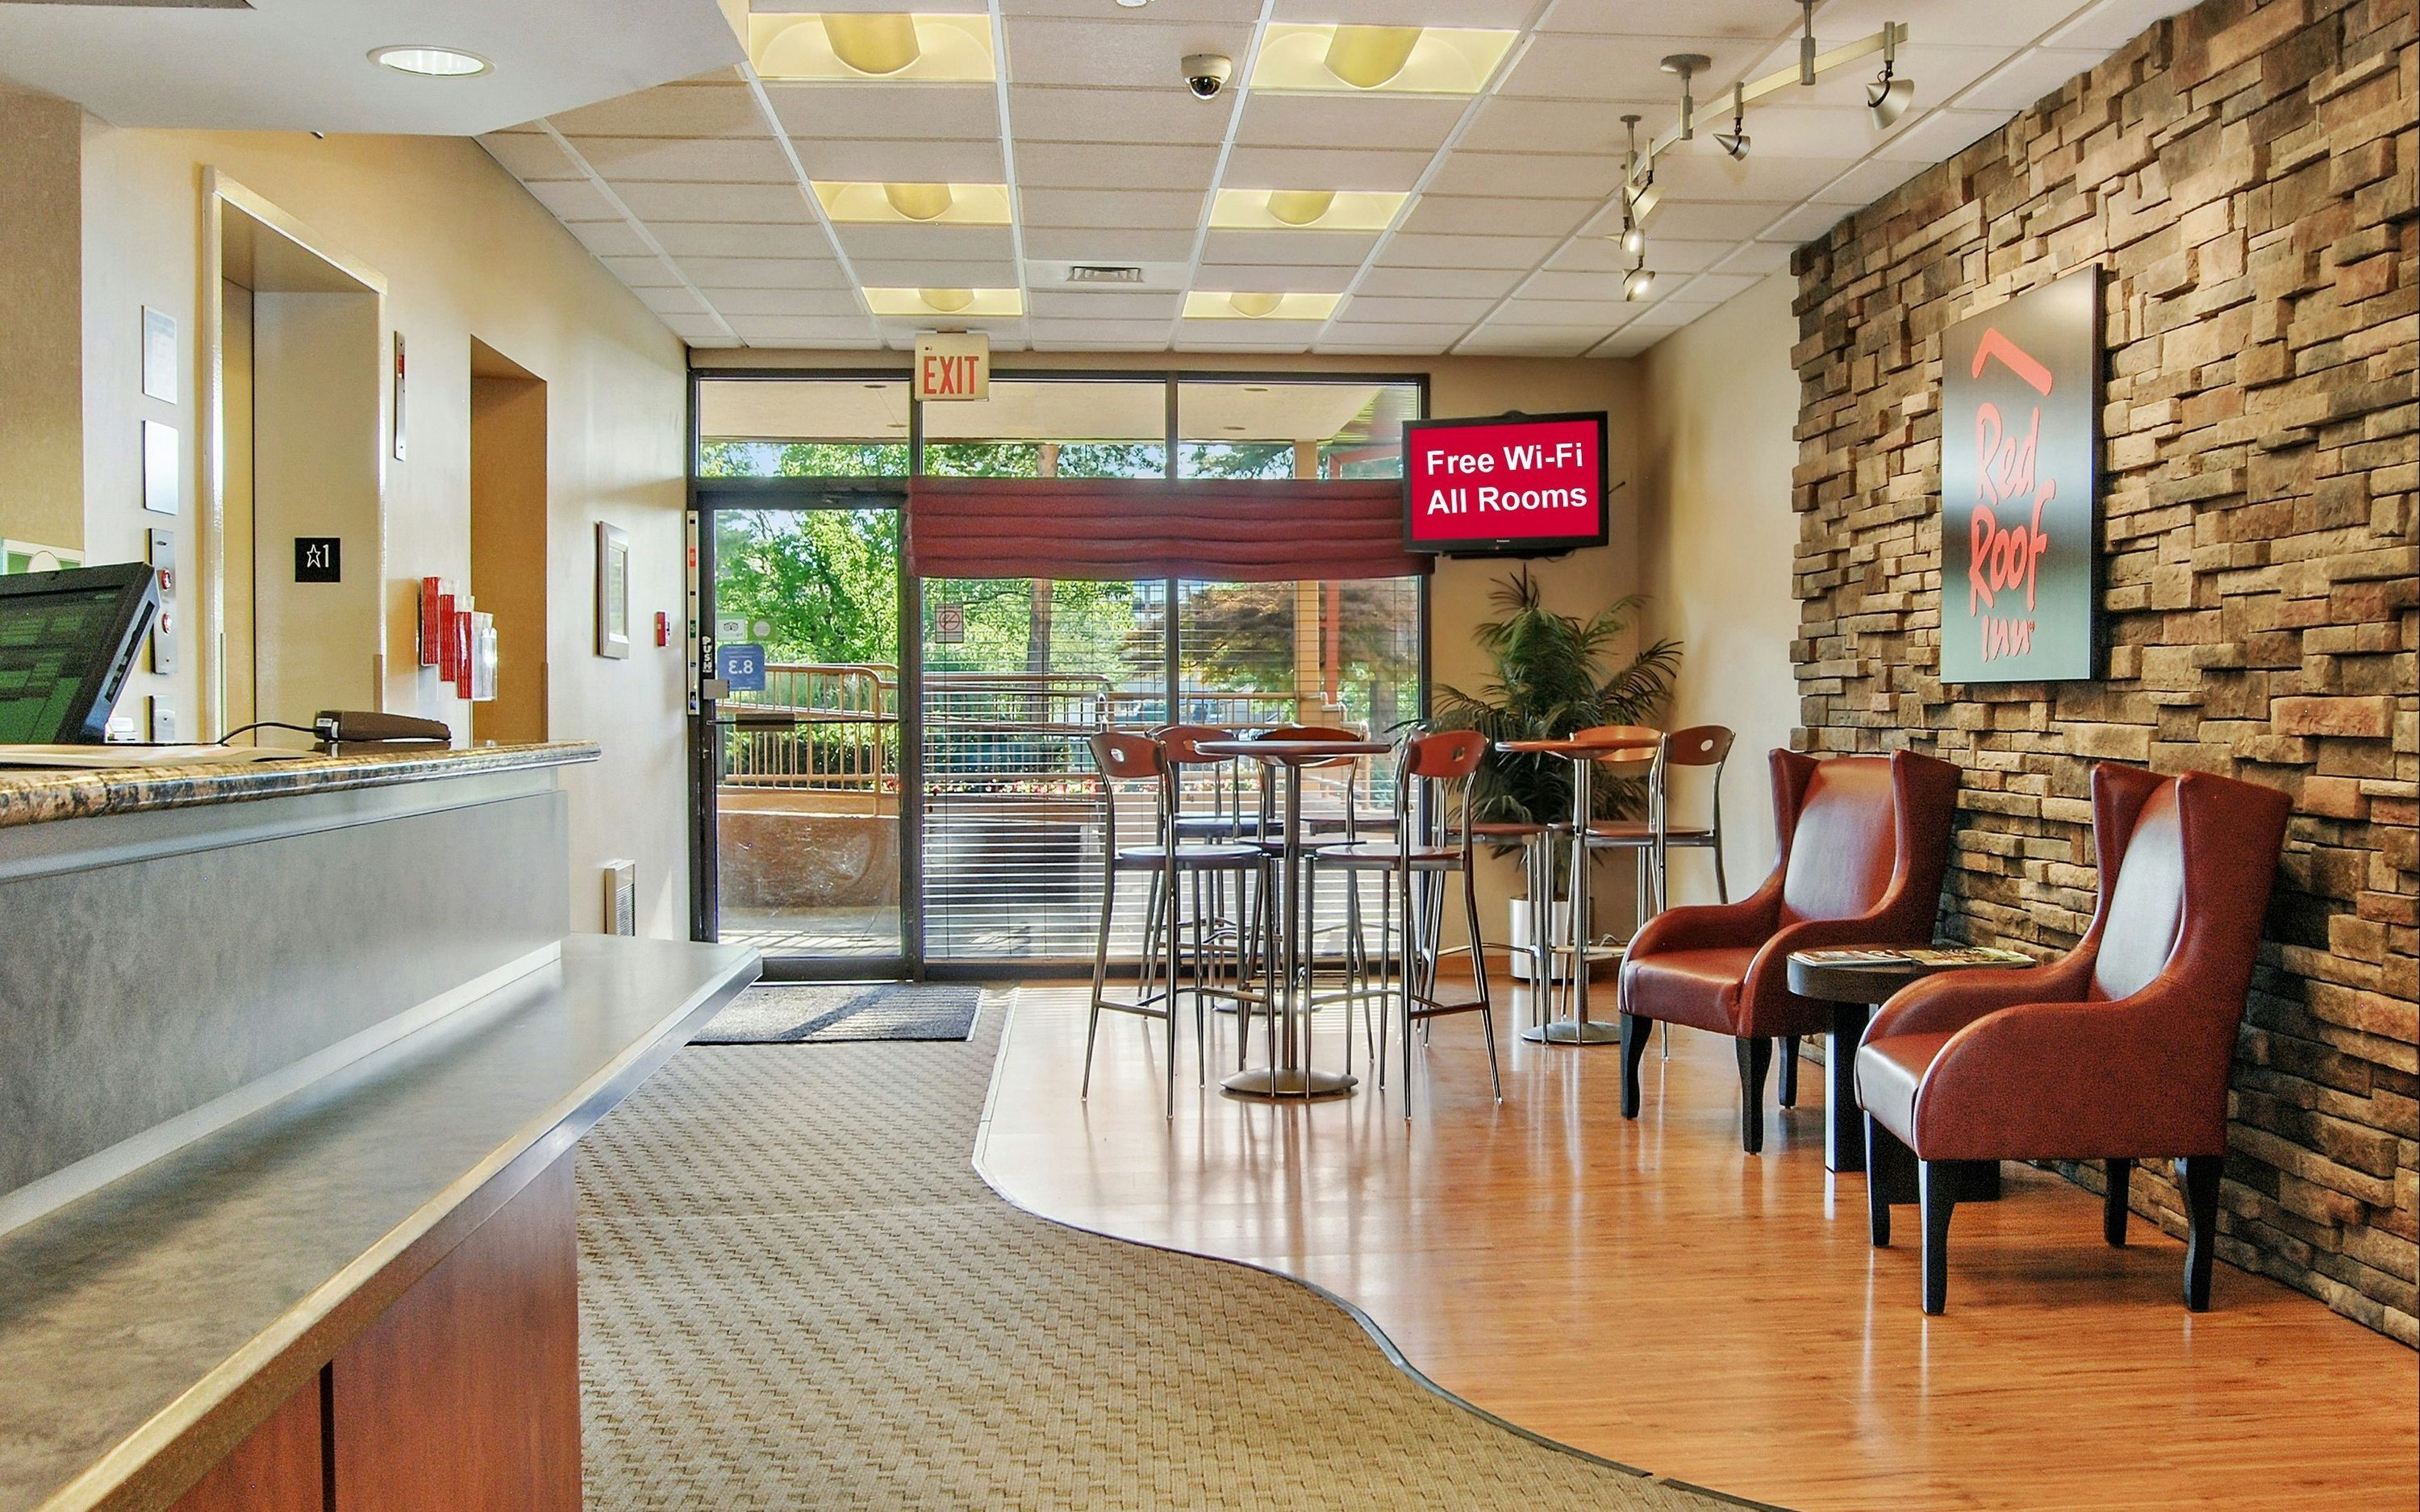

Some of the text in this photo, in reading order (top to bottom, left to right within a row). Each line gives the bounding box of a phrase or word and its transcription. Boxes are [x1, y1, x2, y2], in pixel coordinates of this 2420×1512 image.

[924, 356, 979, 394] EXIT
[1426, 442, 1583, 476] Free Wi-Fi
[1976, 402, 2040, 506] Red
[1426, 486, 1588, 515] All Rooms
[322, 544, 329, 568] 1
[1969, 478, 2056, 617] Roof
[702, 635, 713, 673] PUSH
